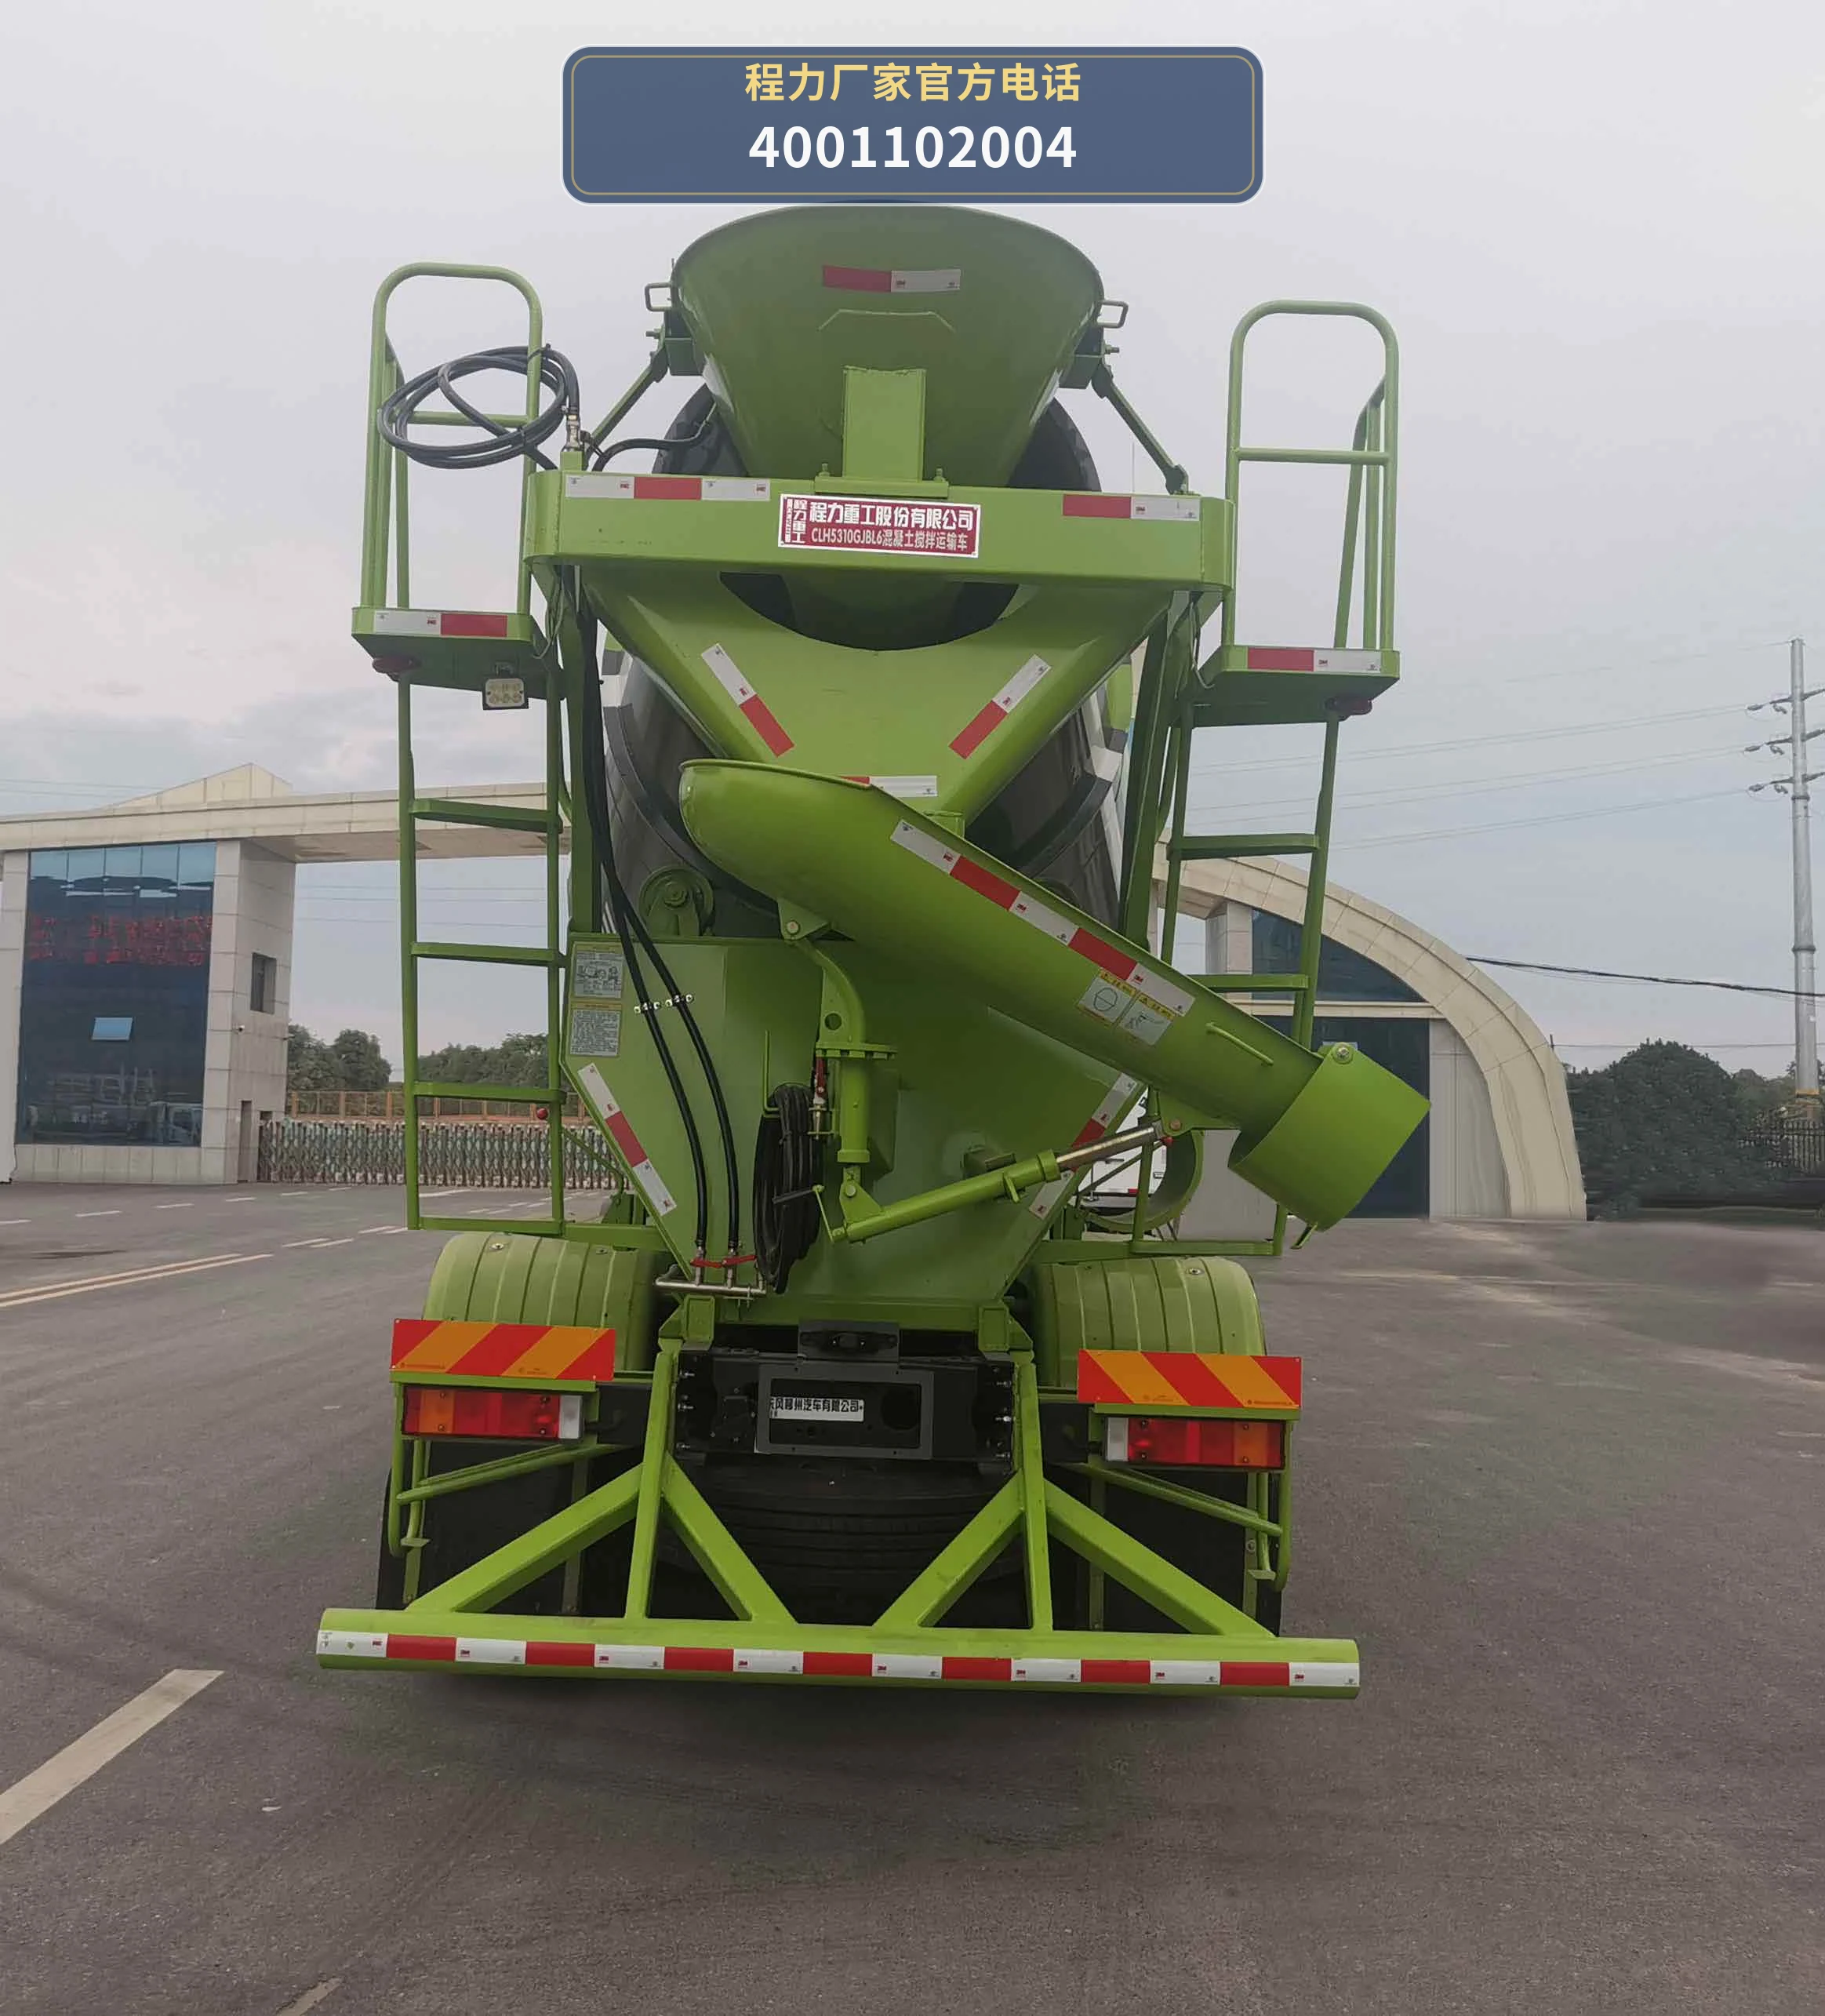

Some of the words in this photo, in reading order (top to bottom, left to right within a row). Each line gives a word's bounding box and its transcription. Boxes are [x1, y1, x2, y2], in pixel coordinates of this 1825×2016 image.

[809, 502, 973, 531] 程力重工股份有限公司
[812, 528, 968, 551] CLH5310GJBL6混凝土搅拌运输车
